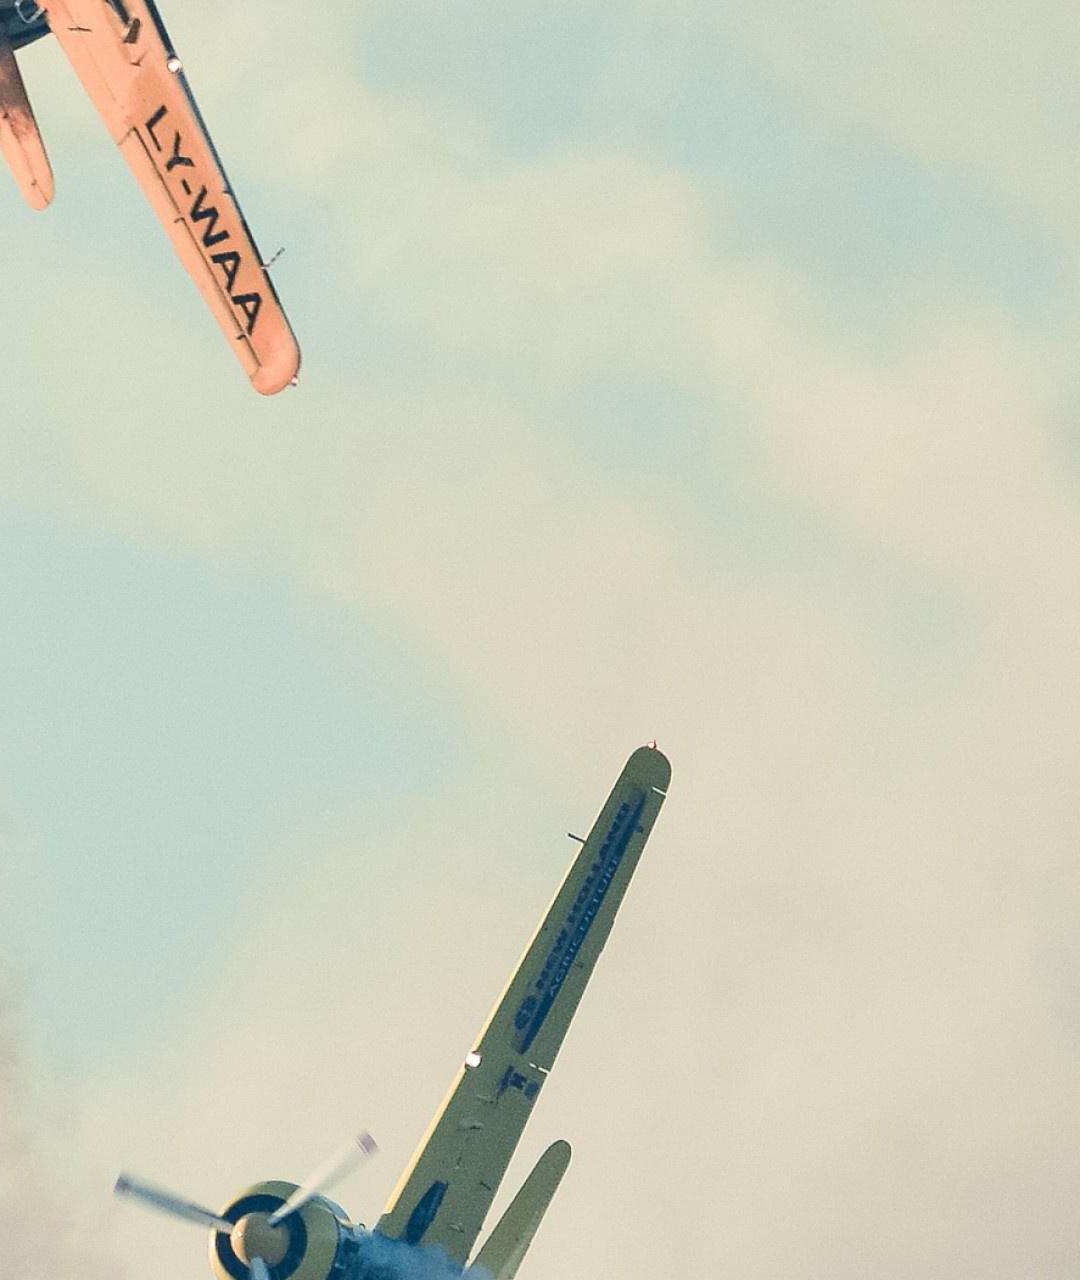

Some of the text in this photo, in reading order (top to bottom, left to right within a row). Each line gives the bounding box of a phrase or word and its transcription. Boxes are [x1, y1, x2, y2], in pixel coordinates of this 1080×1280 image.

[145, 105, 263, 336] LY-WAA
[535, 802, 630, 990] NEW HOLLAND
